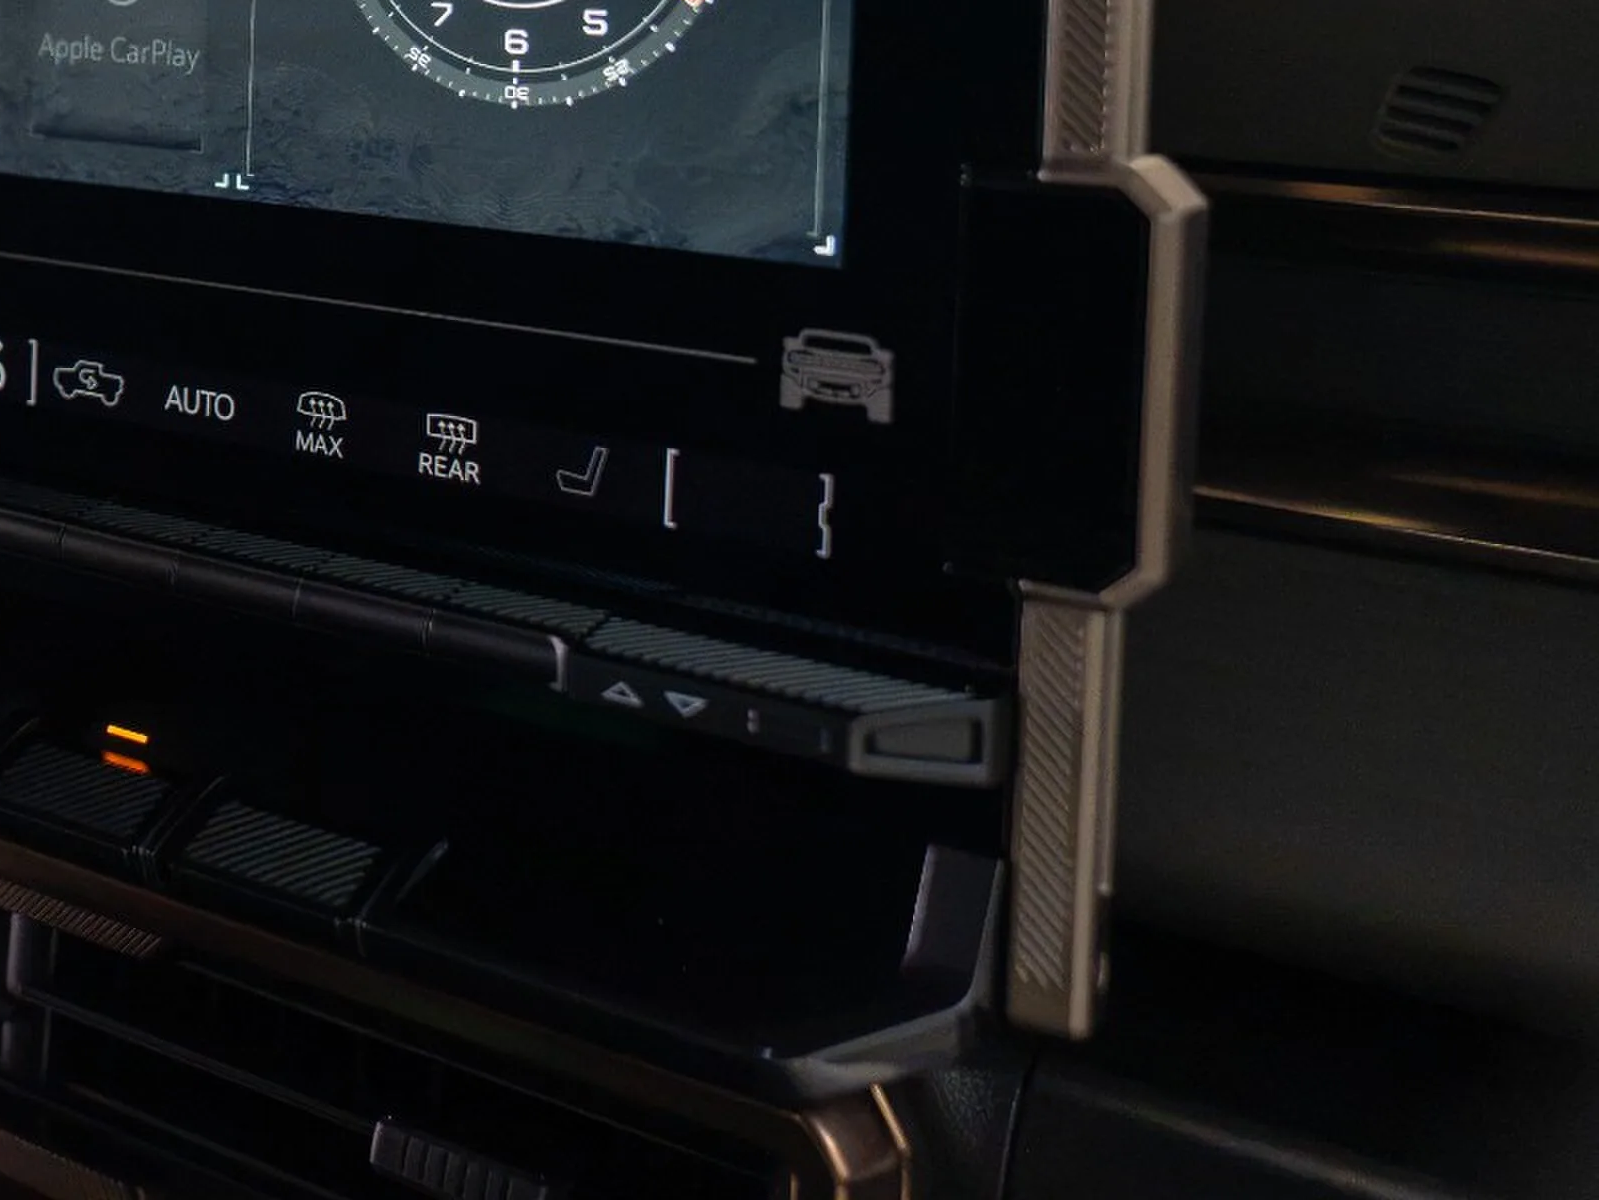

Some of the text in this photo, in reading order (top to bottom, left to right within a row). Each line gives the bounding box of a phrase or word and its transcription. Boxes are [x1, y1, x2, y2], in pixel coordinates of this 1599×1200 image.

[431, 2, 454, 27] 7
[582, 8, 608, 36] 5
[38, 32, 201, 75] Apple CarPlay
[504, 29, 530, 55] 6
[164, 384, 235, 421] AUTO
[295, 434, 344, 458] MAX
[419, 453, 480, 485] REAR
